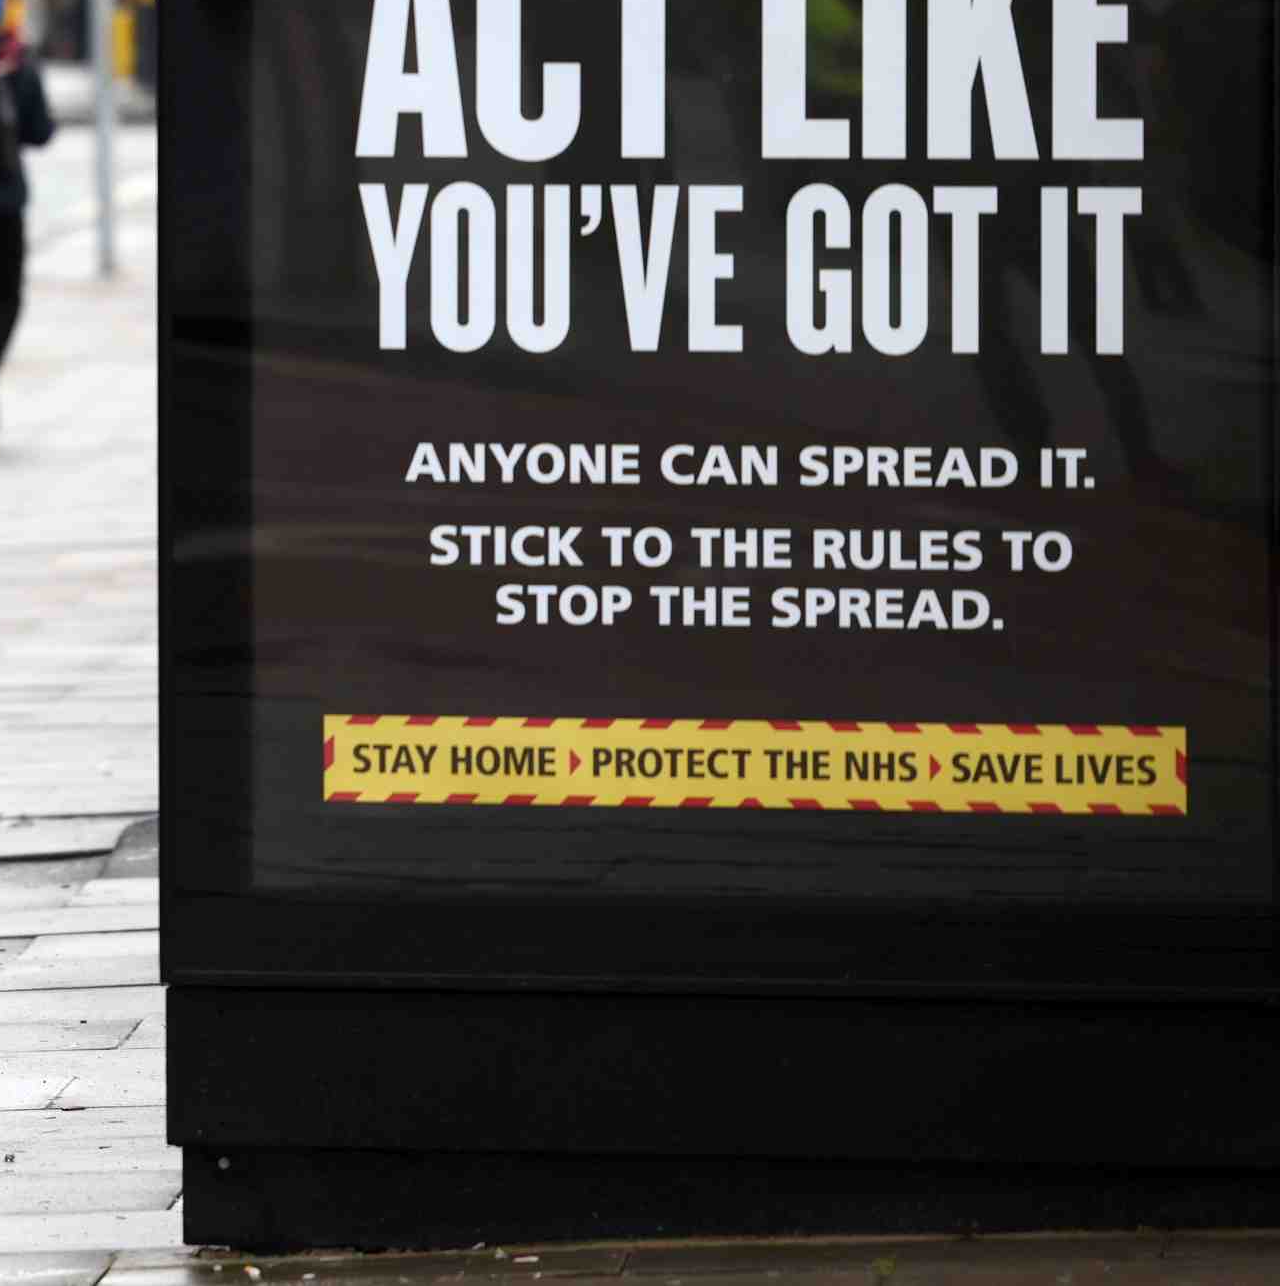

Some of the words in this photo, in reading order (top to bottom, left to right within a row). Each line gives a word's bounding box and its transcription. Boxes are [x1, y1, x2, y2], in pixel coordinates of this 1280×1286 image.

[358, 181, 744, 354] YOU'VE
[786, 183, 998, 356] GOT
[1040, 186, 1143, 355] IT
[405, 442, 641, 485] ANYONE
[660, 444, 778, 486] CAN
[799, 445, 1018, 488] SPREAD
[1040, 448, 1095, 488] IT.
[429, 524, 584, 567] STICK
[601, 526, 673, 568] TO
[690, 527, 792, 569] THE
[813, 529, 983, 571] RULES
[1001, 531, 1073, 572] TO
[495, 583, 633, 626] STOP
[649, 585, 751, 627] THE
[771, 587, 1004, 630] SPREAD.
[353, 744, 437, 774] STAY
[451, 746, 555, 776] HOME
[593, 748, 751, 779] PROTECT
[764, 750, 830, 780] THE
[845, 751, 917, 782] NHS
[952, 753, 1043, 784] SAVE
[1055, 755, 1157, 786] LIVES
